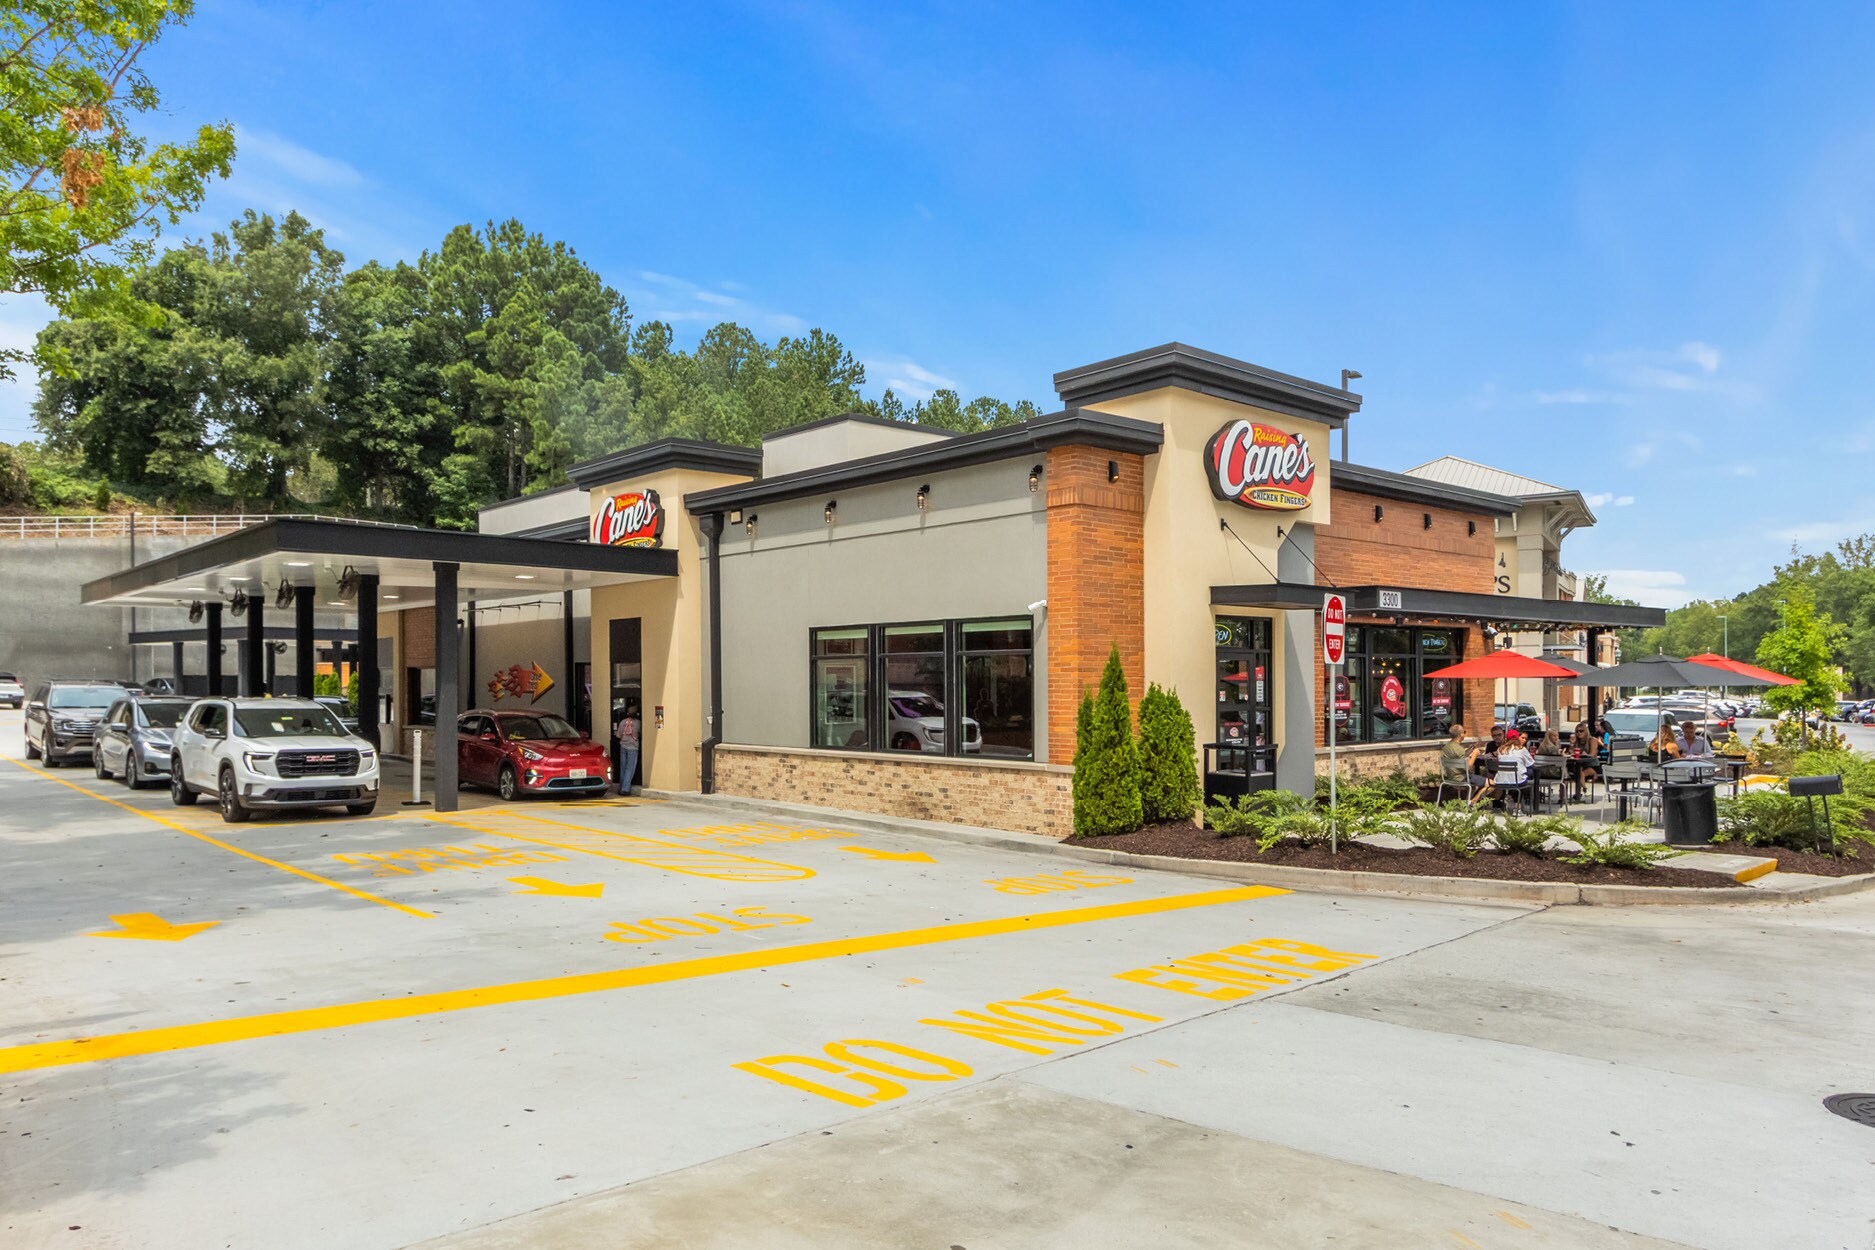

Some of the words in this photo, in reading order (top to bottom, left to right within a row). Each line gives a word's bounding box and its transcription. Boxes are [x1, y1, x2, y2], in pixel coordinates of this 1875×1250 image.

[1253, 427, 1287, 448] Raising
[1219, 419, 1315, 497] Cane's
[615, 495, 638, 511] Raising
[1252, 490, 1279, 502] CHICKEN
[1280, 493, 1305, 506] FINGERS
[594, 489, 657, 545] Cane's
[1382, 592, 1399, 607] 3300
[1327, 607, 1335, 619] DO
[1334, 608, 1343, 620] NOT
[1328, 638, 1341, 650] ENTER
[305, 754, 336, 763] GMC
[331, 843, 518, 865] THRU
[351, 851, 571, 877] DRIVE
[981, 869, 1135, 896] STOP
[602, 906, 813, 944] STOP
[729, 1039, 975, 1109] DO
[916, 988, 1166, 1057] NOT
[1111, 937, 1381, 1002] ENTER
